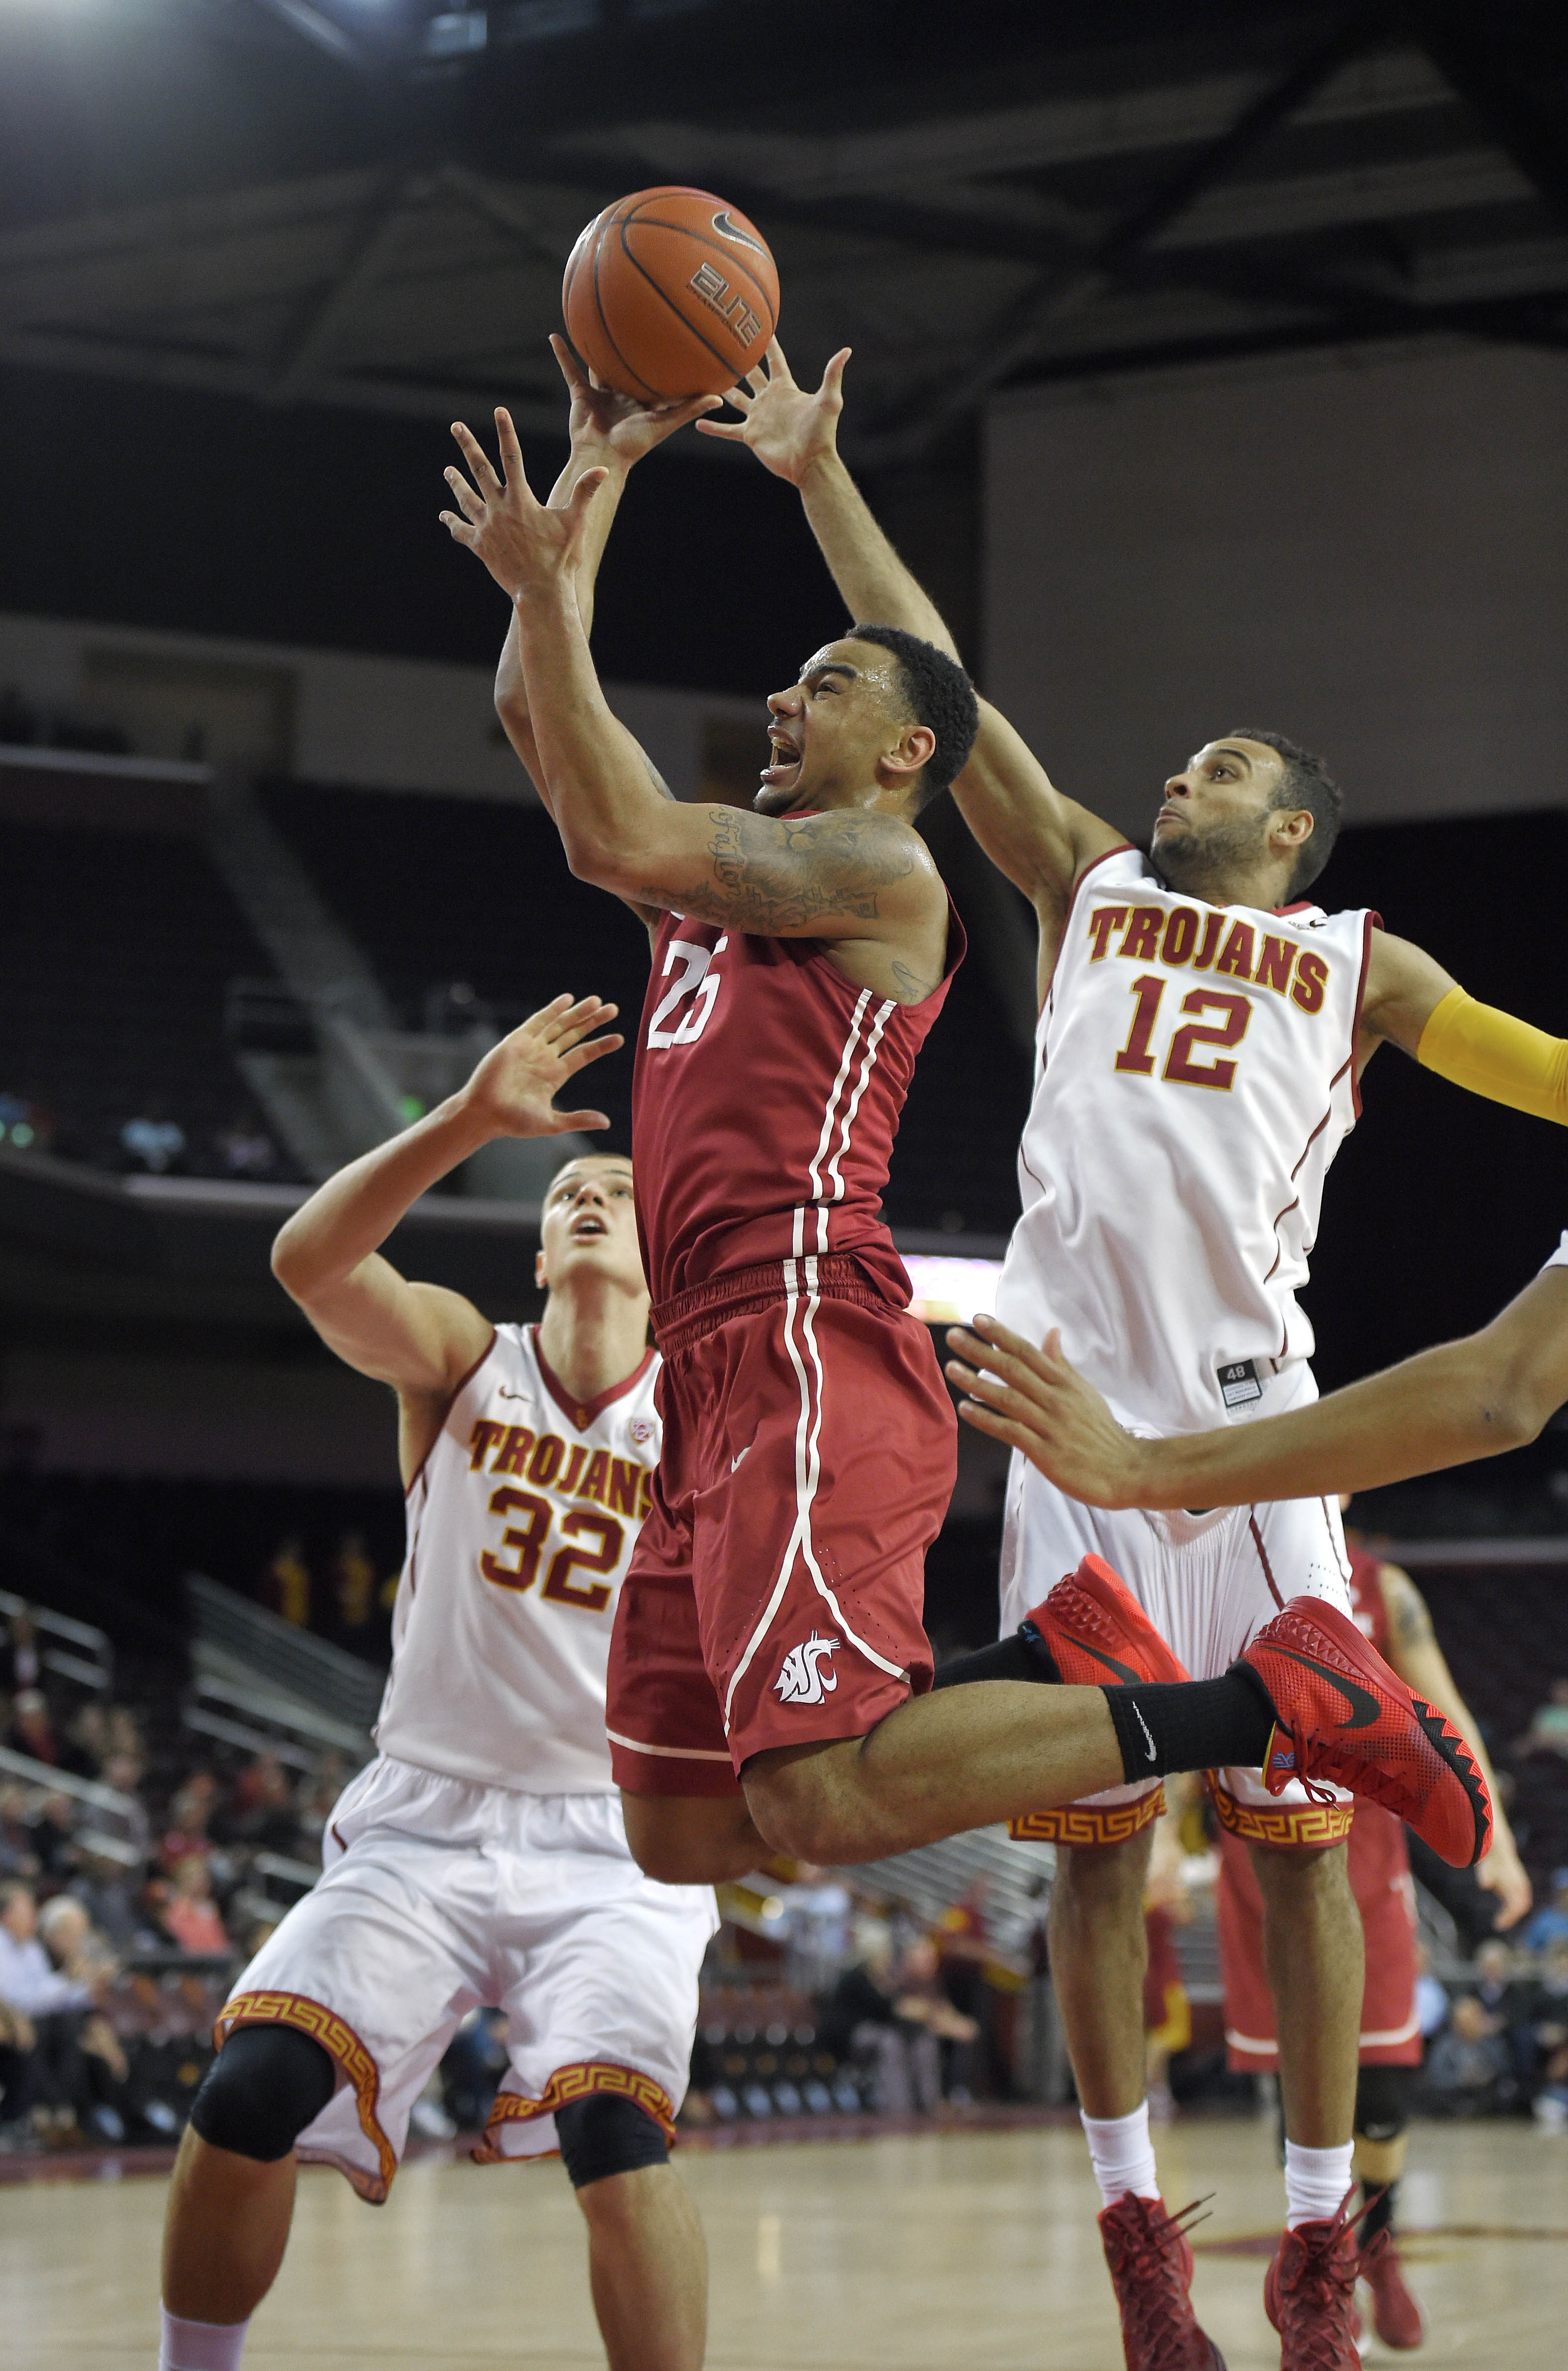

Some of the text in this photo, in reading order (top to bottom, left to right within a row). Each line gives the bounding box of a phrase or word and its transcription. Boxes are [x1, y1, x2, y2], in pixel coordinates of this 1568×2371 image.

[691, 263, 762, 346] ELITE
[1088, 906, 1330, 1015] TROJANS
[1115, 975, 1254, 1091] 12
[1227, 1365, 1246, 1380] 48
[480, 1485, 625, 1612] 32
